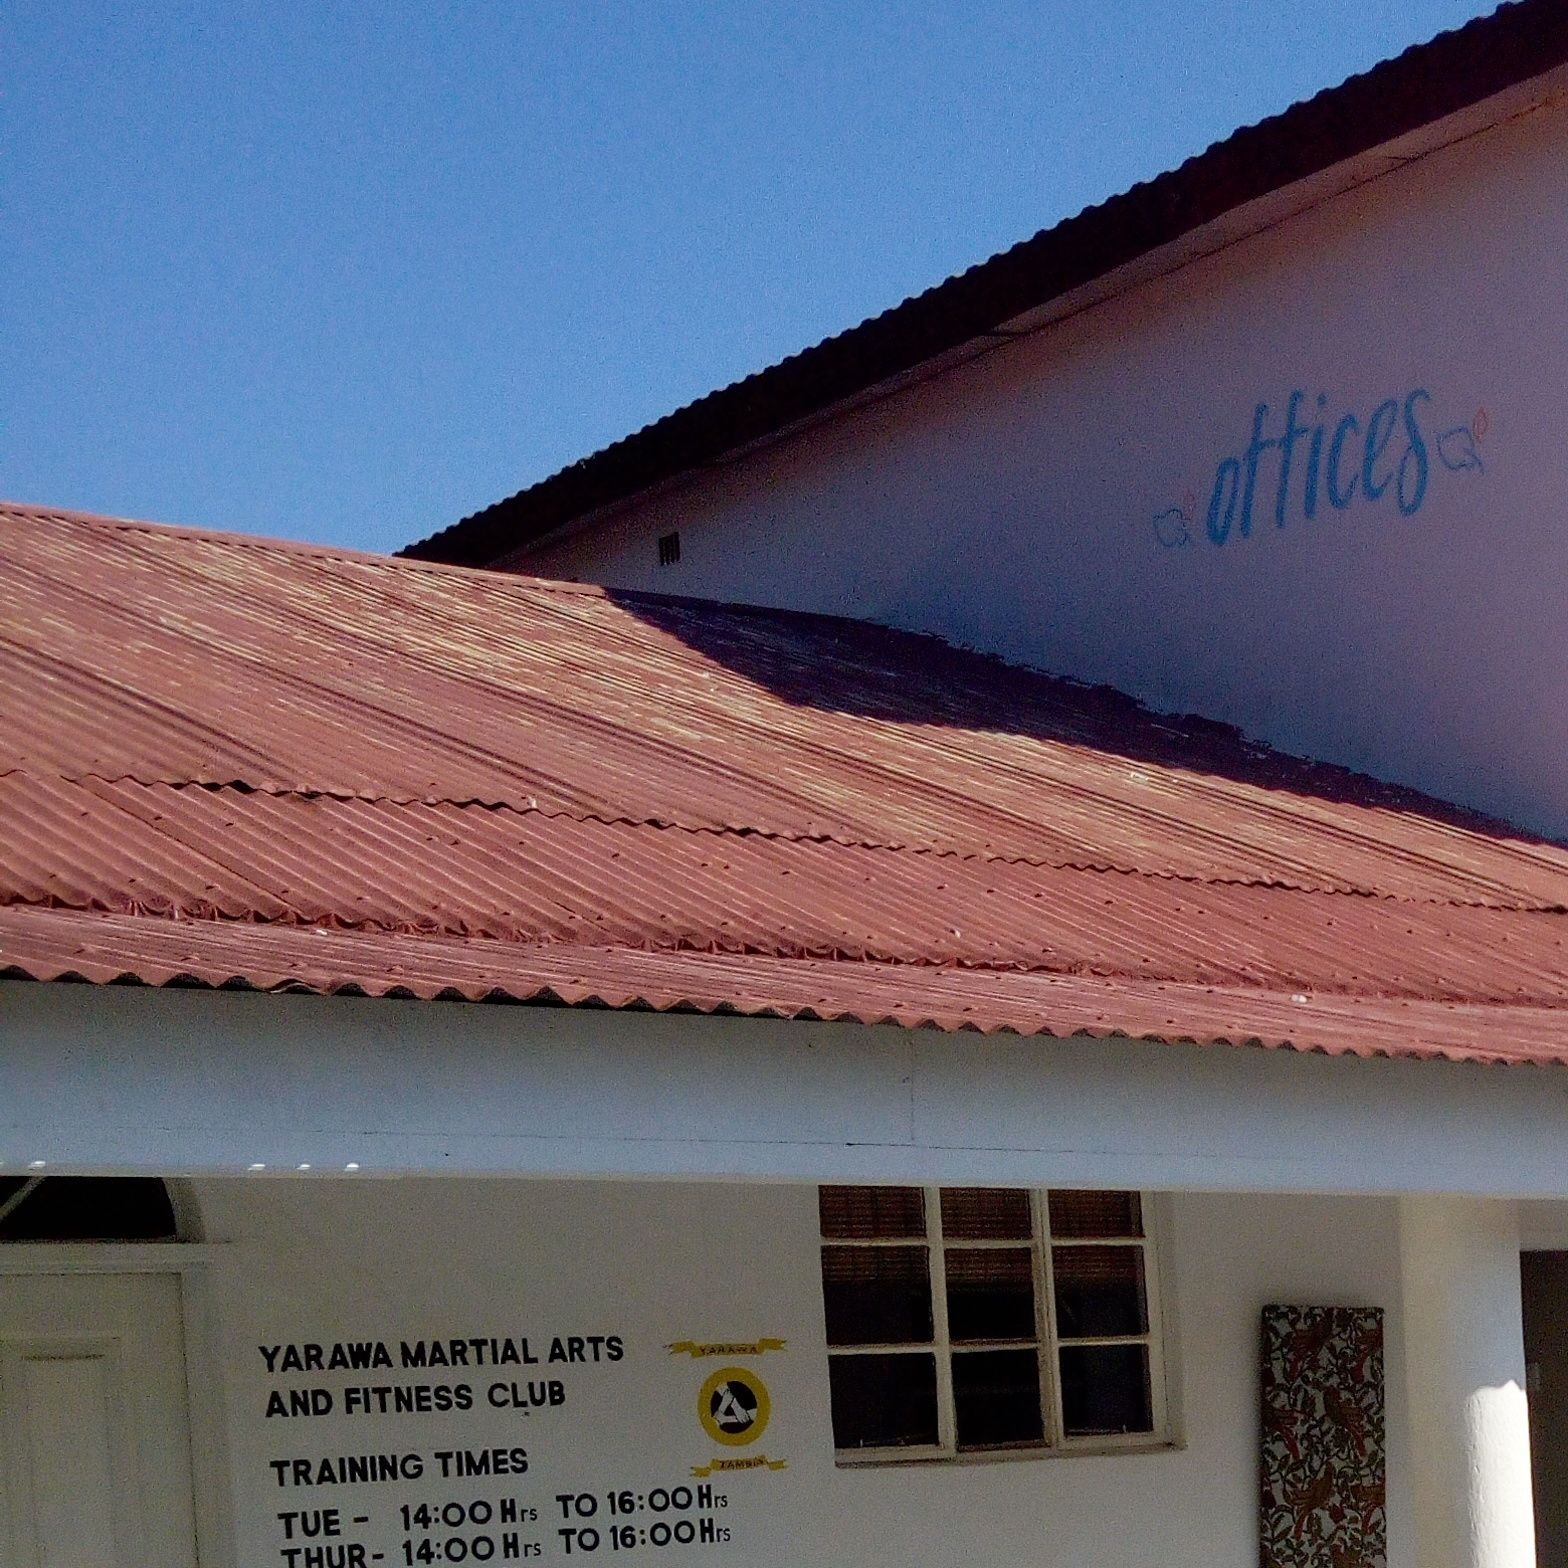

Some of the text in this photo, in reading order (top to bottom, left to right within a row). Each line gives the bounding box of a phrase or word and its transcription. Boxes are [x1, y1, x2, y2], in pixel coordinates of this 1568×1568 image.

[1207, 388, 1431, 547] offices
[258, 1335, 625, 1374] YARAWA MARTIAL ARTS
[264, 1380, 566, 1419] AND FITNESS CLUB
[268, 1447, 529, 1488] TRAINING TIMES
[276, 1508, 342, 1540] TUE
[555, 1492, 598, 1519] TO
[557, 1527, 601, 1555] TO
